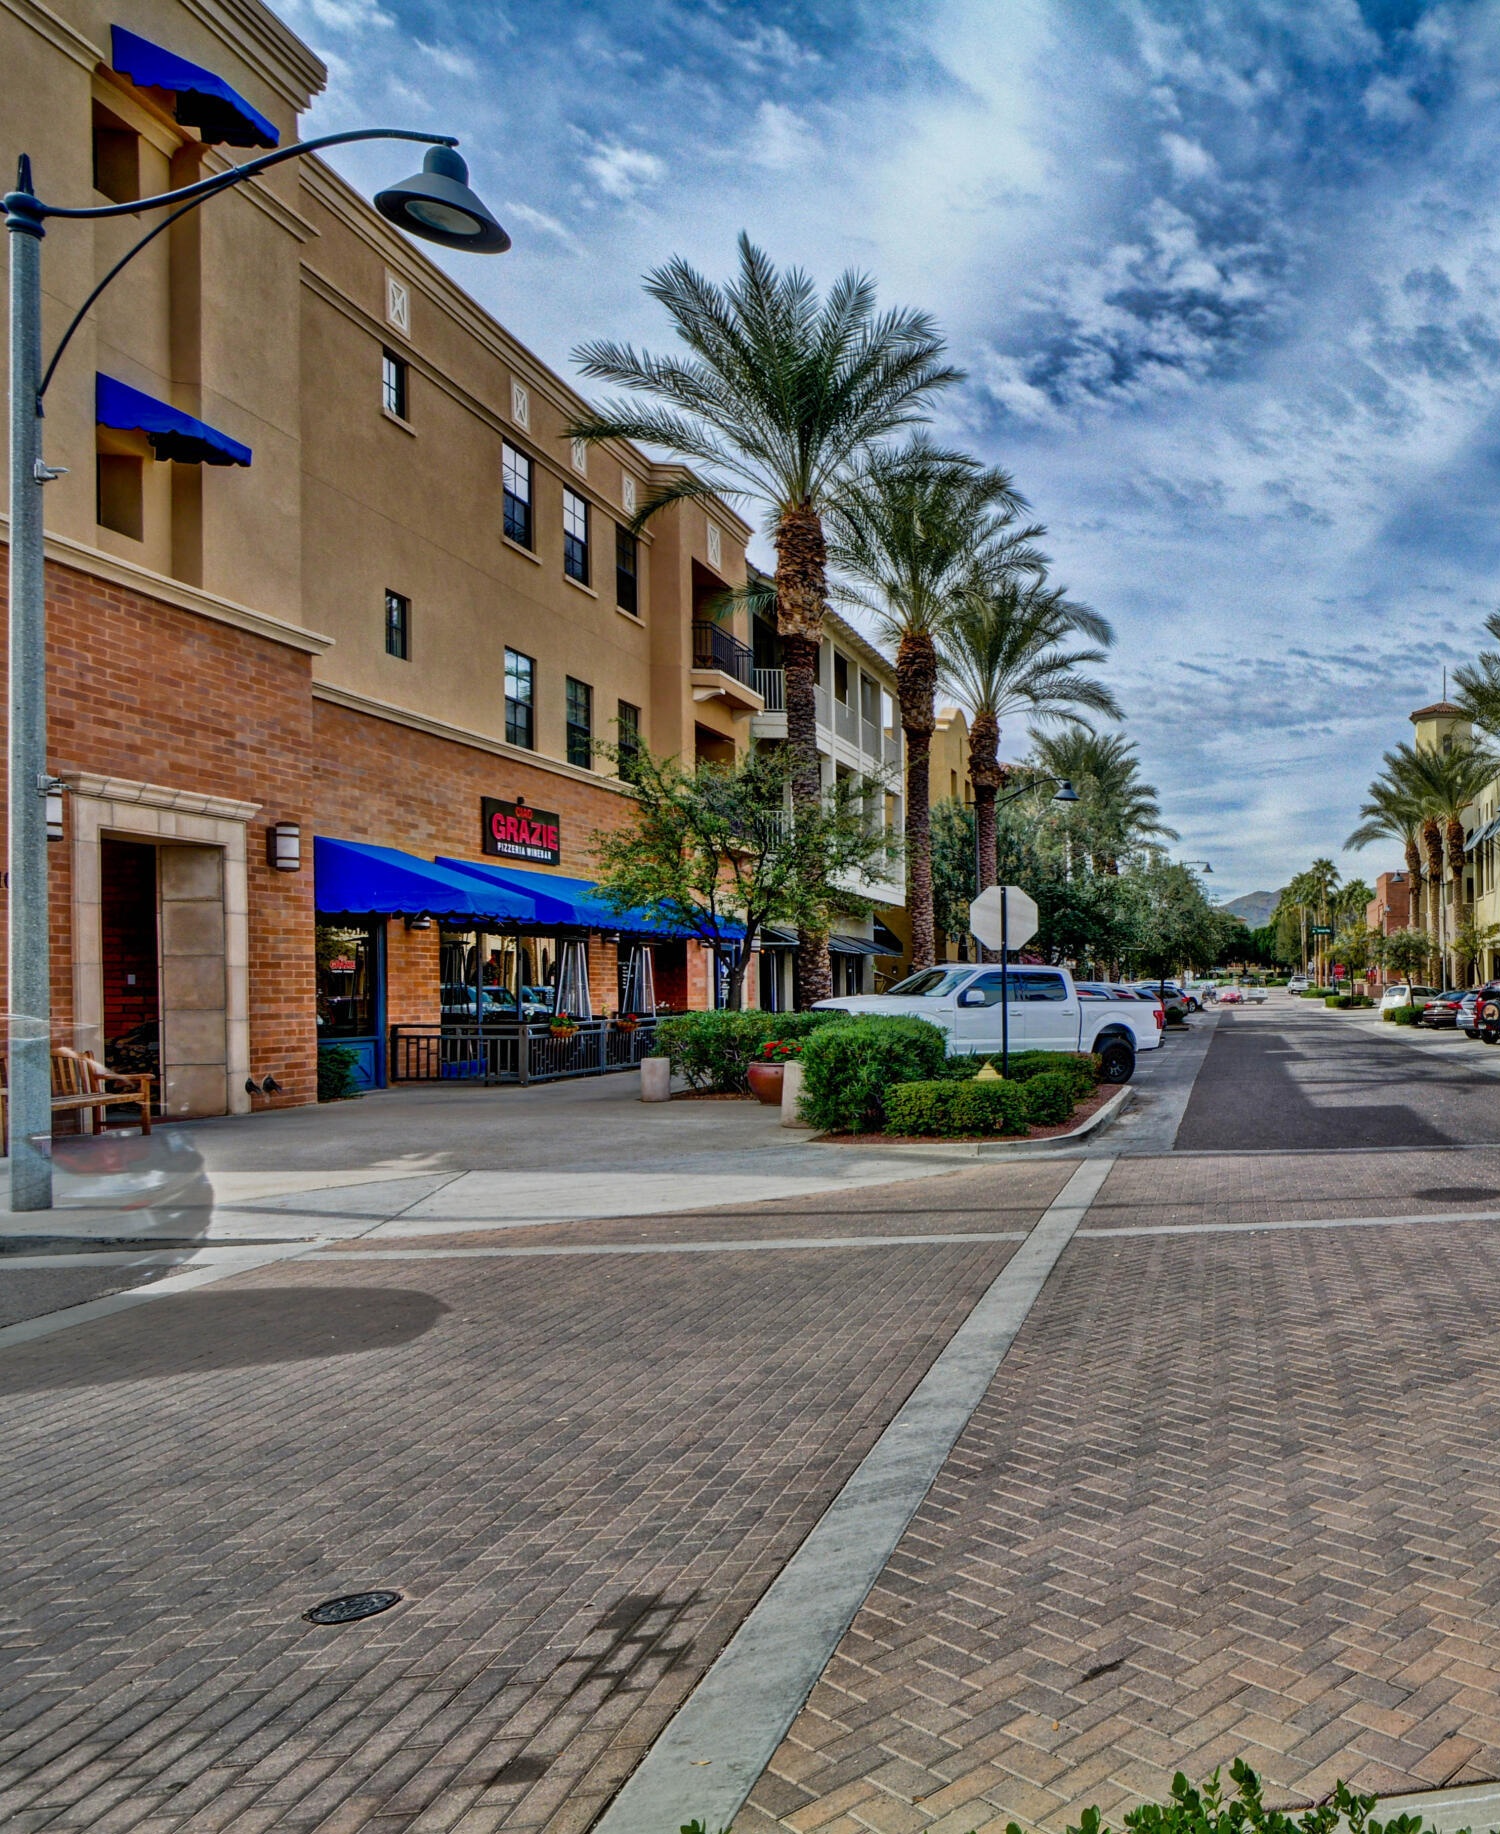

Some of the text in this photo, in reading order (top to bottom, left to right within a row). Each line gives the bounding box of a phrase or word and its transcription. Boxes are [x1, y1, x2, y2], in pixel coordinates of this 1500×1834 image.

[491, 812, 559, 851] GRAZIE
[497, 841, 552, 860] PIZZERIA WINEBAR
